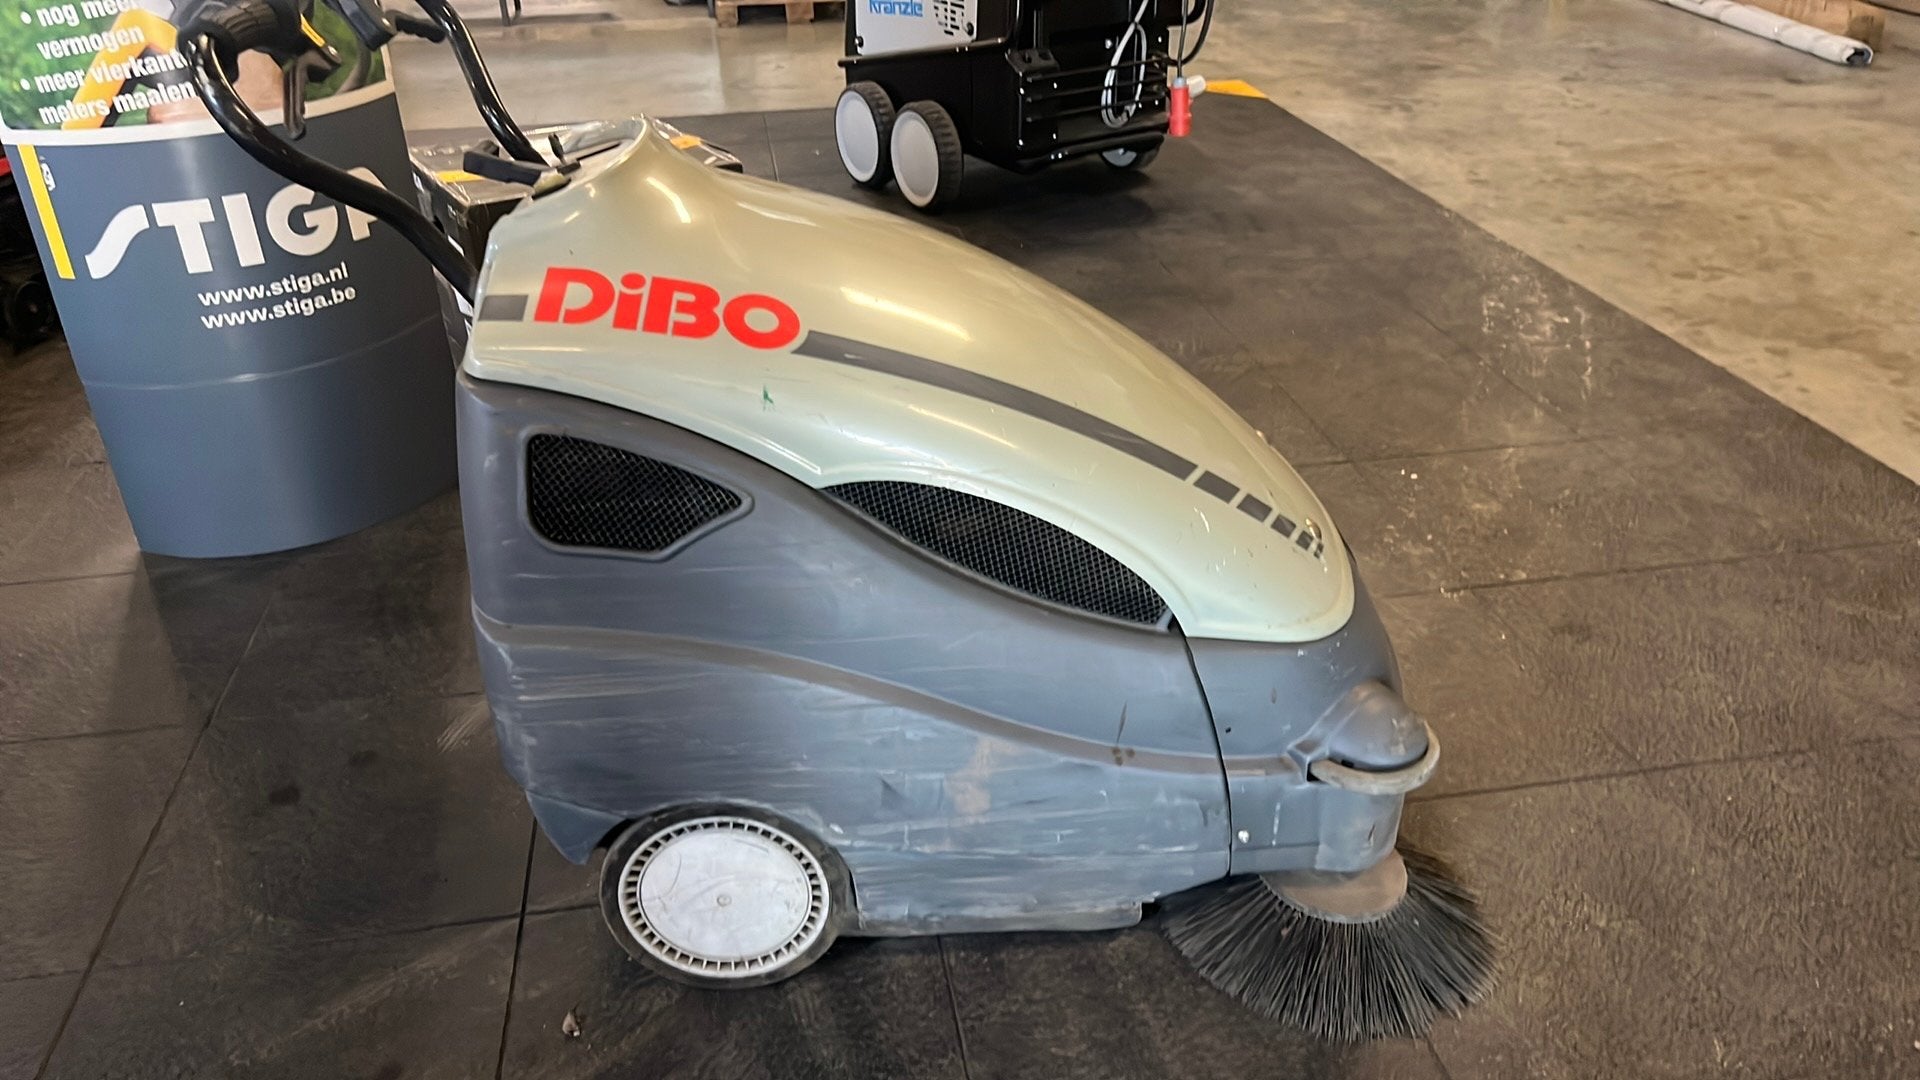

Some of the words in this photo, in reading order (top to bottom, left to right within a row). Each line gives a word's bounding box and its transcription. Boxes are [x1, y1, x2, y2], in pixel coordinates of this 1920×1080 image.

[36, 3, 80, 27] nog
[37, 25, 146, 60] vermogen
[34, 68, 87, 94] meer
[38, 98, 111, 125] meters
[113, 80, 197, 113] maalen
[198, 261, 349, 306] www.stiga.nl
[201, 286, 357, 329] www.stiga.be
[533, 266, 801, 350] DiBO
